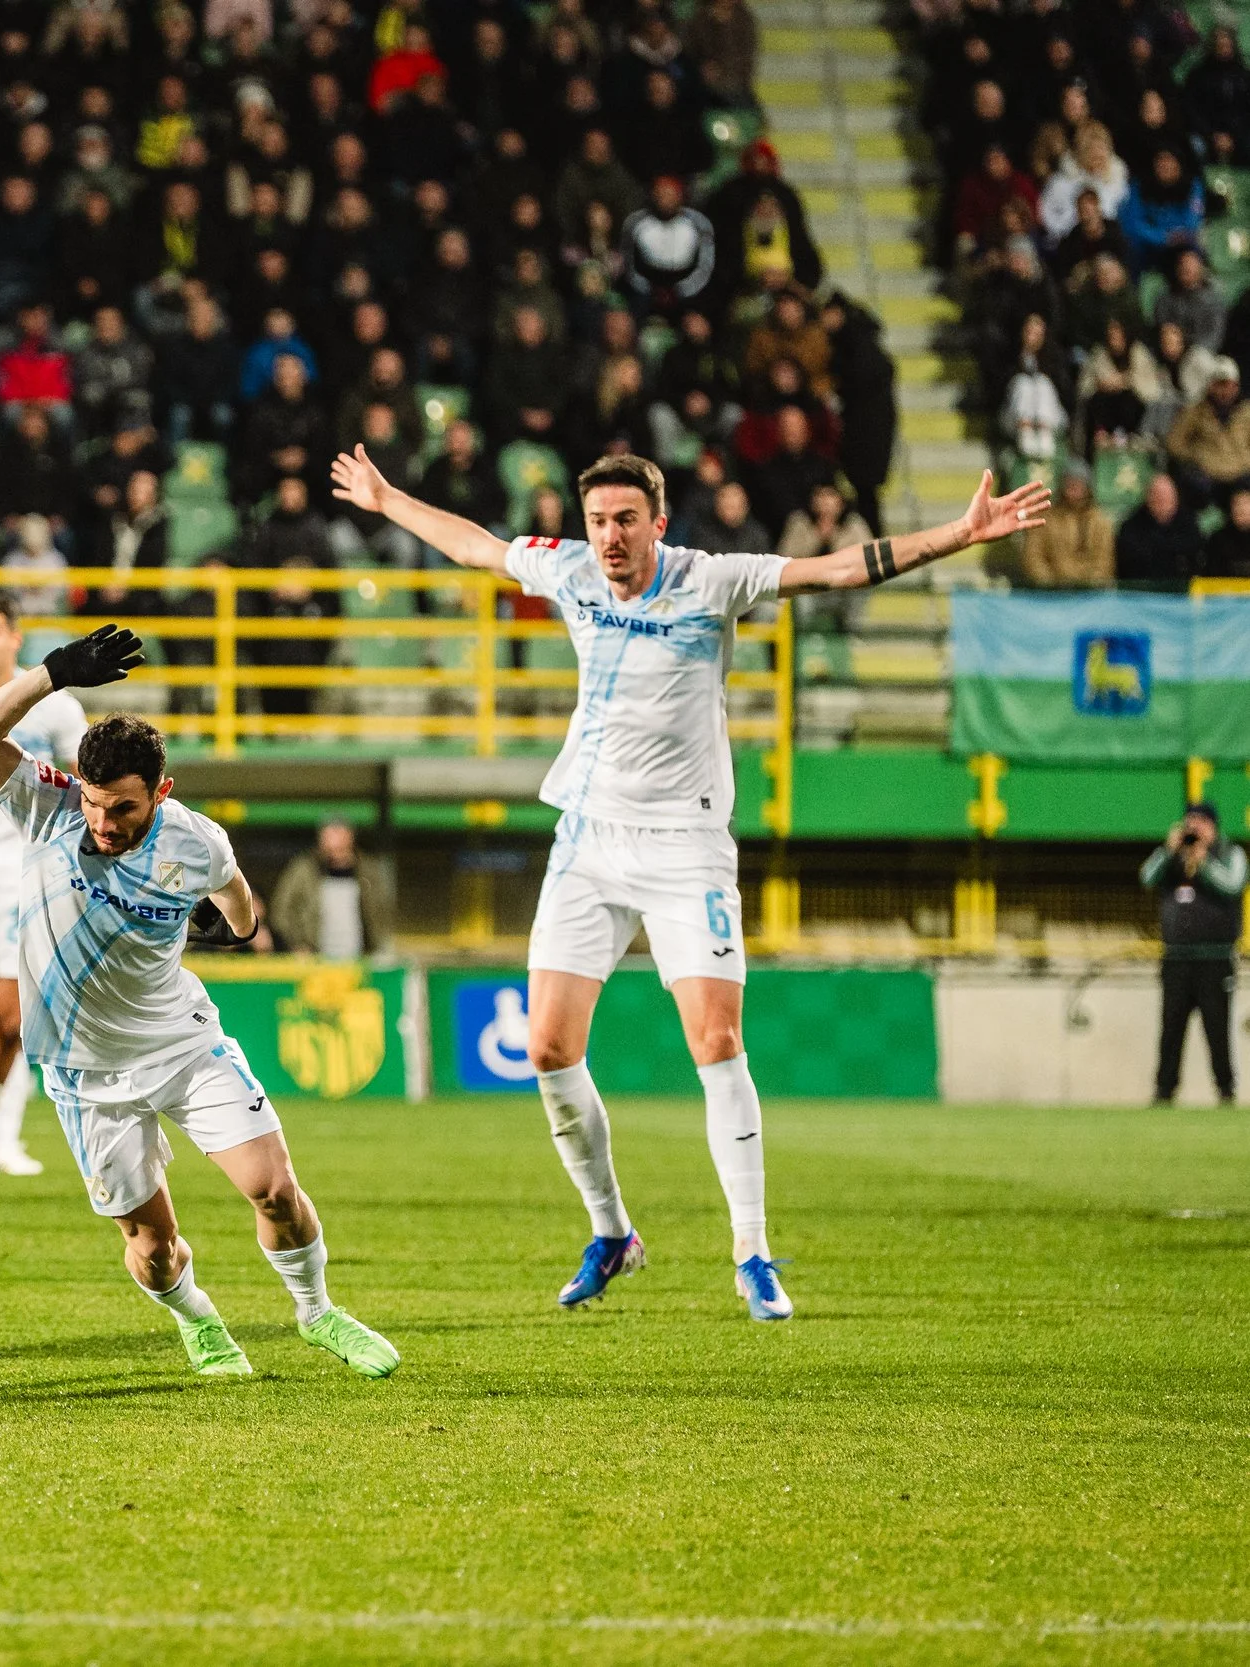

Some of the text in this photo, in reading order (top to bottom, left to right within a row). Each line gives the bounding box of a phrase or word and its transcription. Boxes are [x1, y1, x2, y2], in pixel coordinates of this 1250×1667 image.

[591, 610, 674, 637] FAVBET
[91, 886, 186, 921] FAVBET
[705, 891, 731, 939] 6
